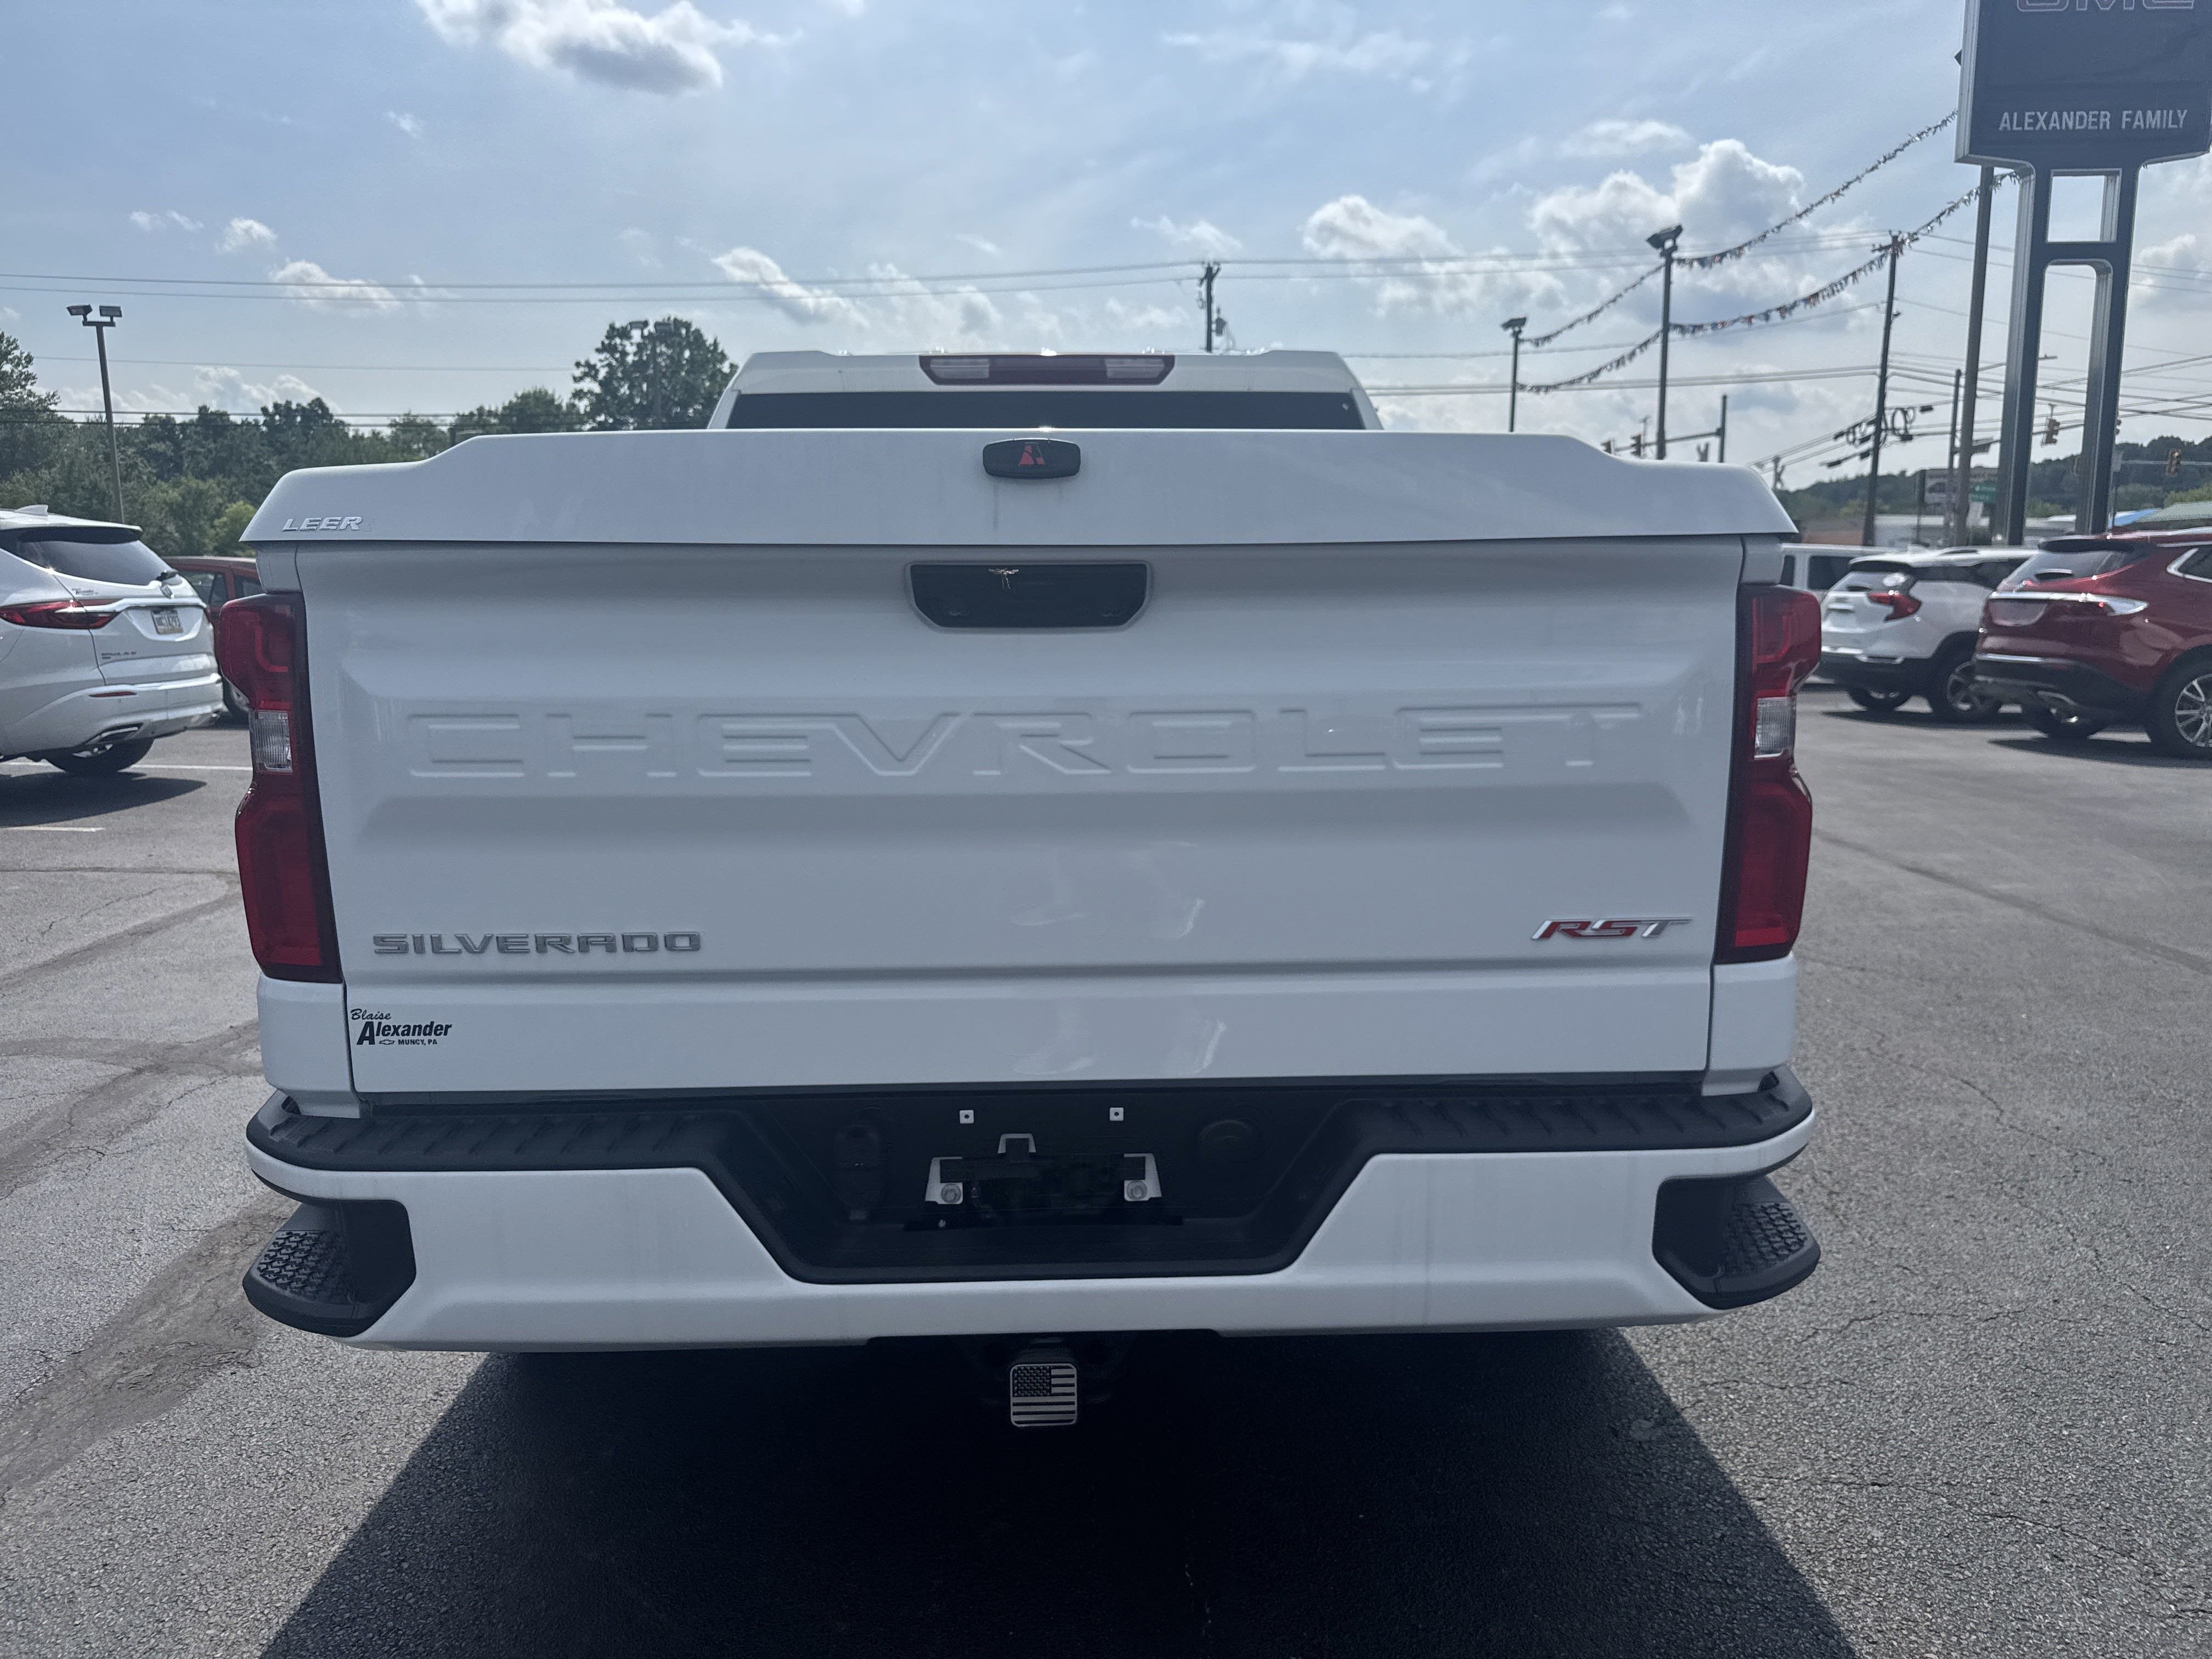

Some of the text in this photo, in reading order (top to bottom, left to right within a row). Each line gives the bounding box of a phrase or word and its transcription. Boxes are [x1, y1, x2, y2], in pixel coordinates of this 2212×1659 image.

[1999, 110, 2187, 132] ALEXANDER FAMILY
[281, 516, 363, 532] LEER
[407, 702, 1642, 778] CHEVROLET
[1531, 916, 1692, 940] RST
[373, 933, 701, 954] SILVERADO
[350, 1008, 392, 1020] Blaise
[357, 1021, 452, 1045] Alexander
